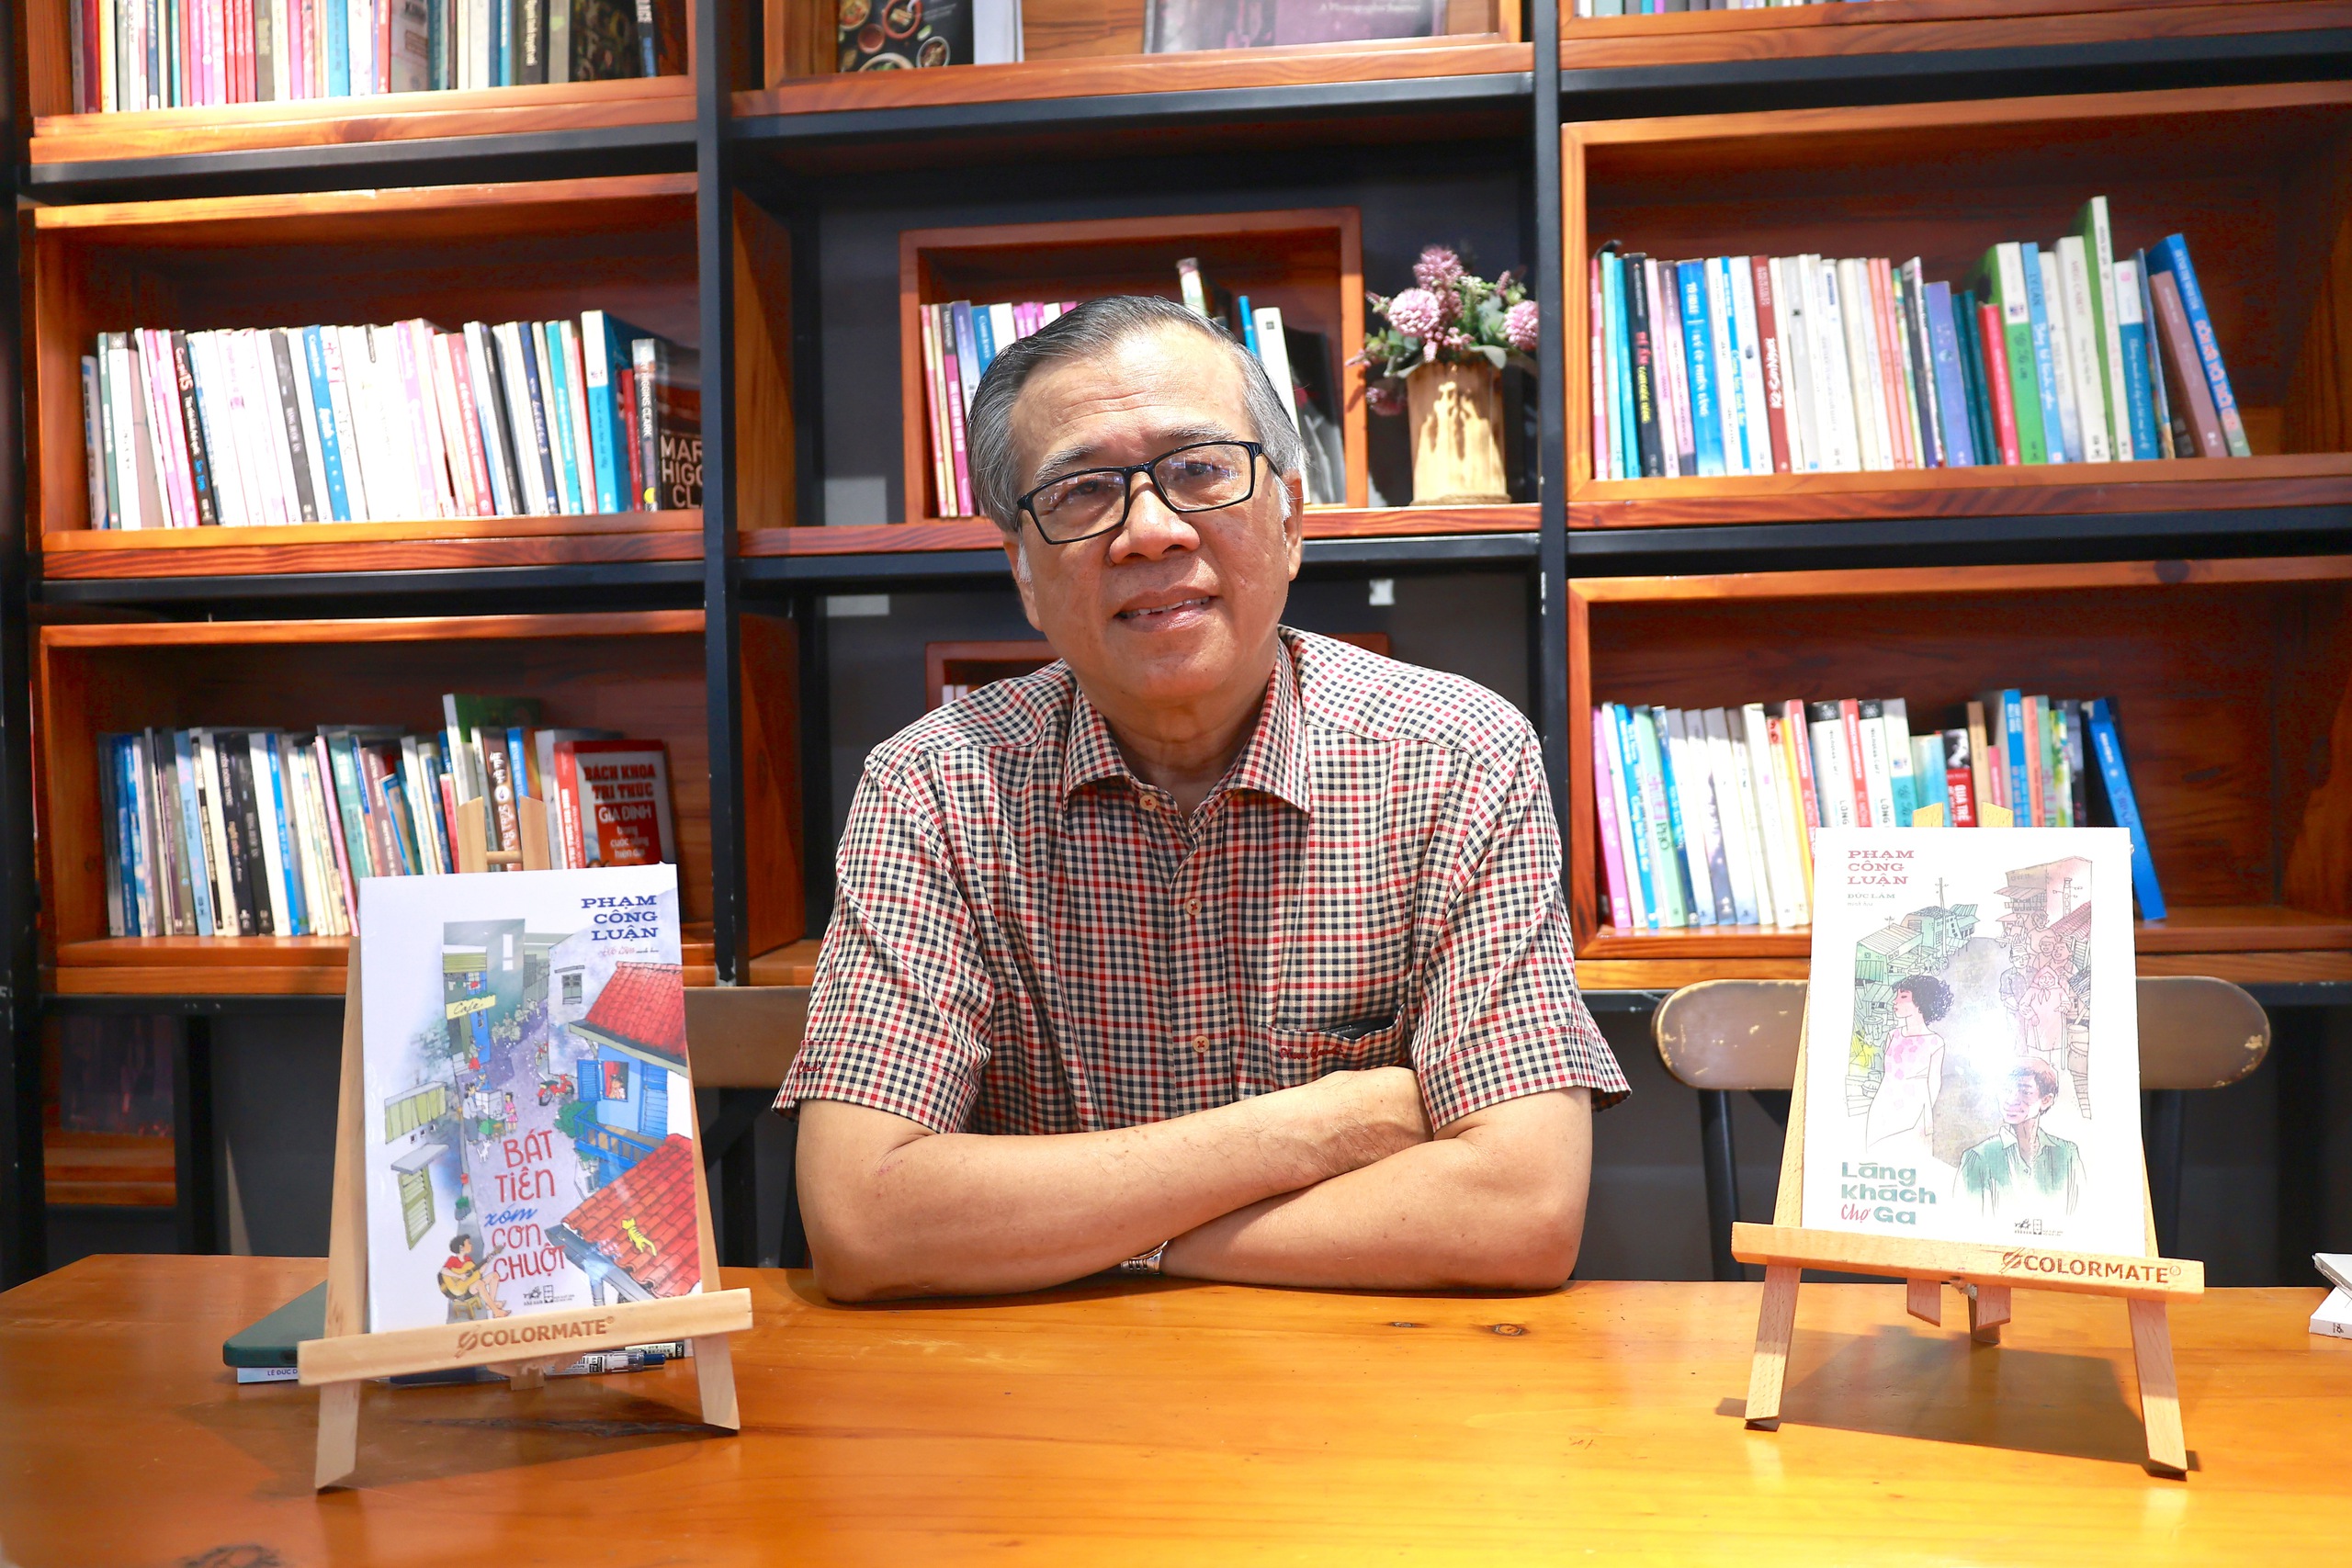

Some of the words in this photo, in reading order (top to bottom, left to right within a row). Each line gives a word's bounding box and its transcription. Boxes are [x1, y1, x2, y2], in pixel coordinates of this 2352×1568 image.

[641, 372, 650, 406] HIGGINS
[642, 407, 652, 436] CLARK
[673, 484, 703, 509] CL
[621, 763, 656, 780] KHOA
[592, 784, 615, 800] TRI
[598, 807, 620, 823] GIA
[1848, 850, 1915, 861] PHẠM
[1848, 860, 1905, 872] CÔNG
[1848, 873, 1909, 886] LUẬN
[581, 895, 657, 909] PHẠM
[594, 909, 658, 924] CÔNG
[592, 925, 659, 942] LUẬN
[503, 1128, 553, 1168] BÁT
[484, 1202, 537, 1227] xóm
[1873, 1206, 1917, 1225] Ga
[493, 1243, 566, 1282] CHUỘT
[2023, 1255, 2169, 1283] COLORMATE
[481, 1319, 606, 1348] COLORMATE
